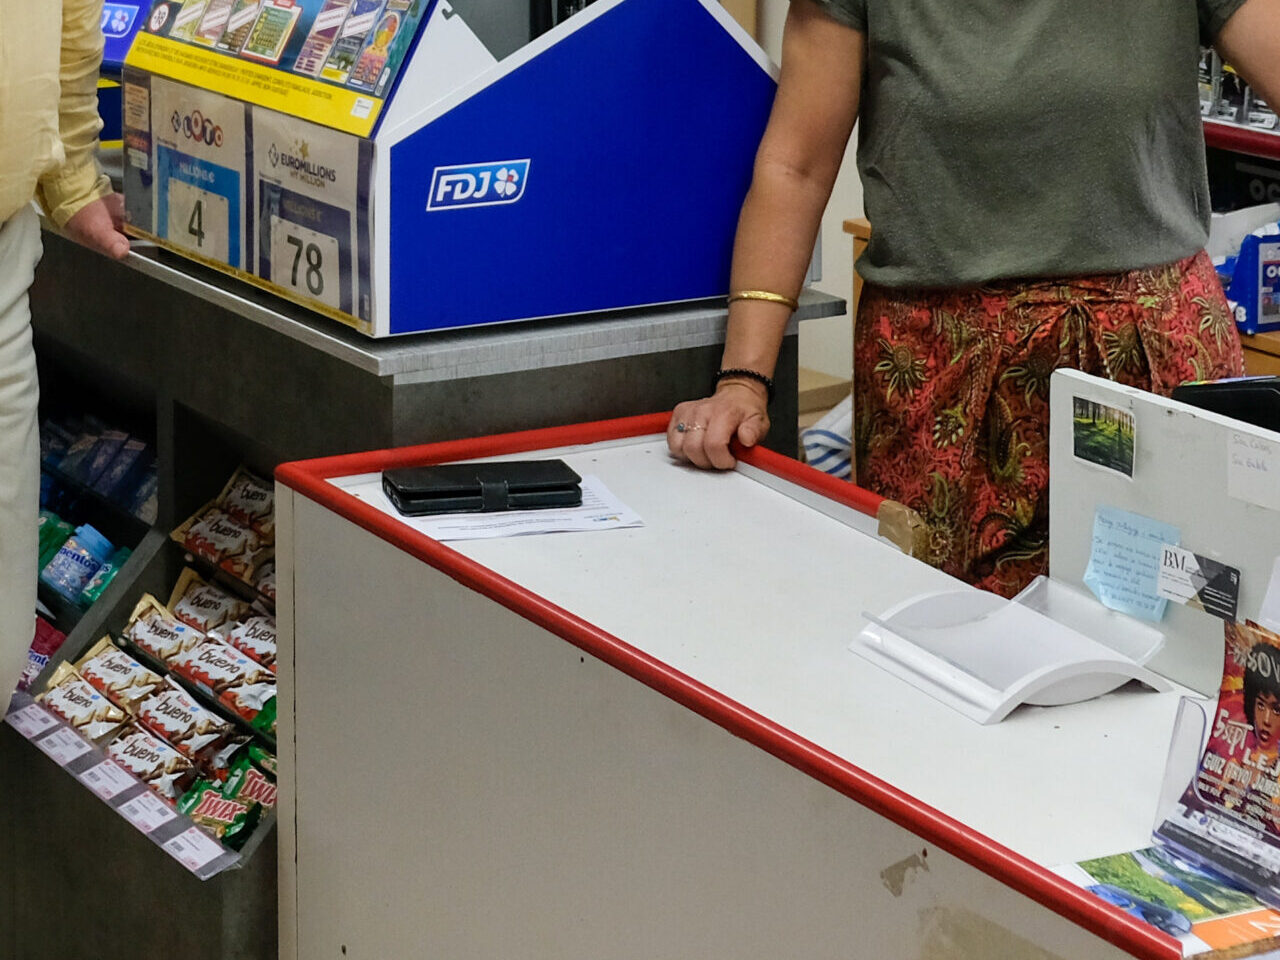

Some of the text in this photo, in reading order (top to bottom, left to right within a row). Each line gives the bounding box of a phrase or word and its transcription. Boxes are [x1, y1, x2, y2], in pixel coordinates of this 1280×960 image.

[183, 110, 223, 147] LOTO
[281, 152, 336, 182] EUROMILLIONS
[436, 171, 492, 202] FDJ
[188, 199, 205, 247] 4
[286, 235, 324, 297] 78
[240, 482, 267, 501] bueno
[209, 519, 242, 538] bueno
[189, 591, 222, 610] bueno
[148, 619, 179, 641] bueno
[100, 656, 132, 675] bueno
[198, 649, 241, 674] bueno
[62, 686, 93, 708] bueno
[155, 696, 193, 724] bueno
[123, 739, 160, 764] bueno
